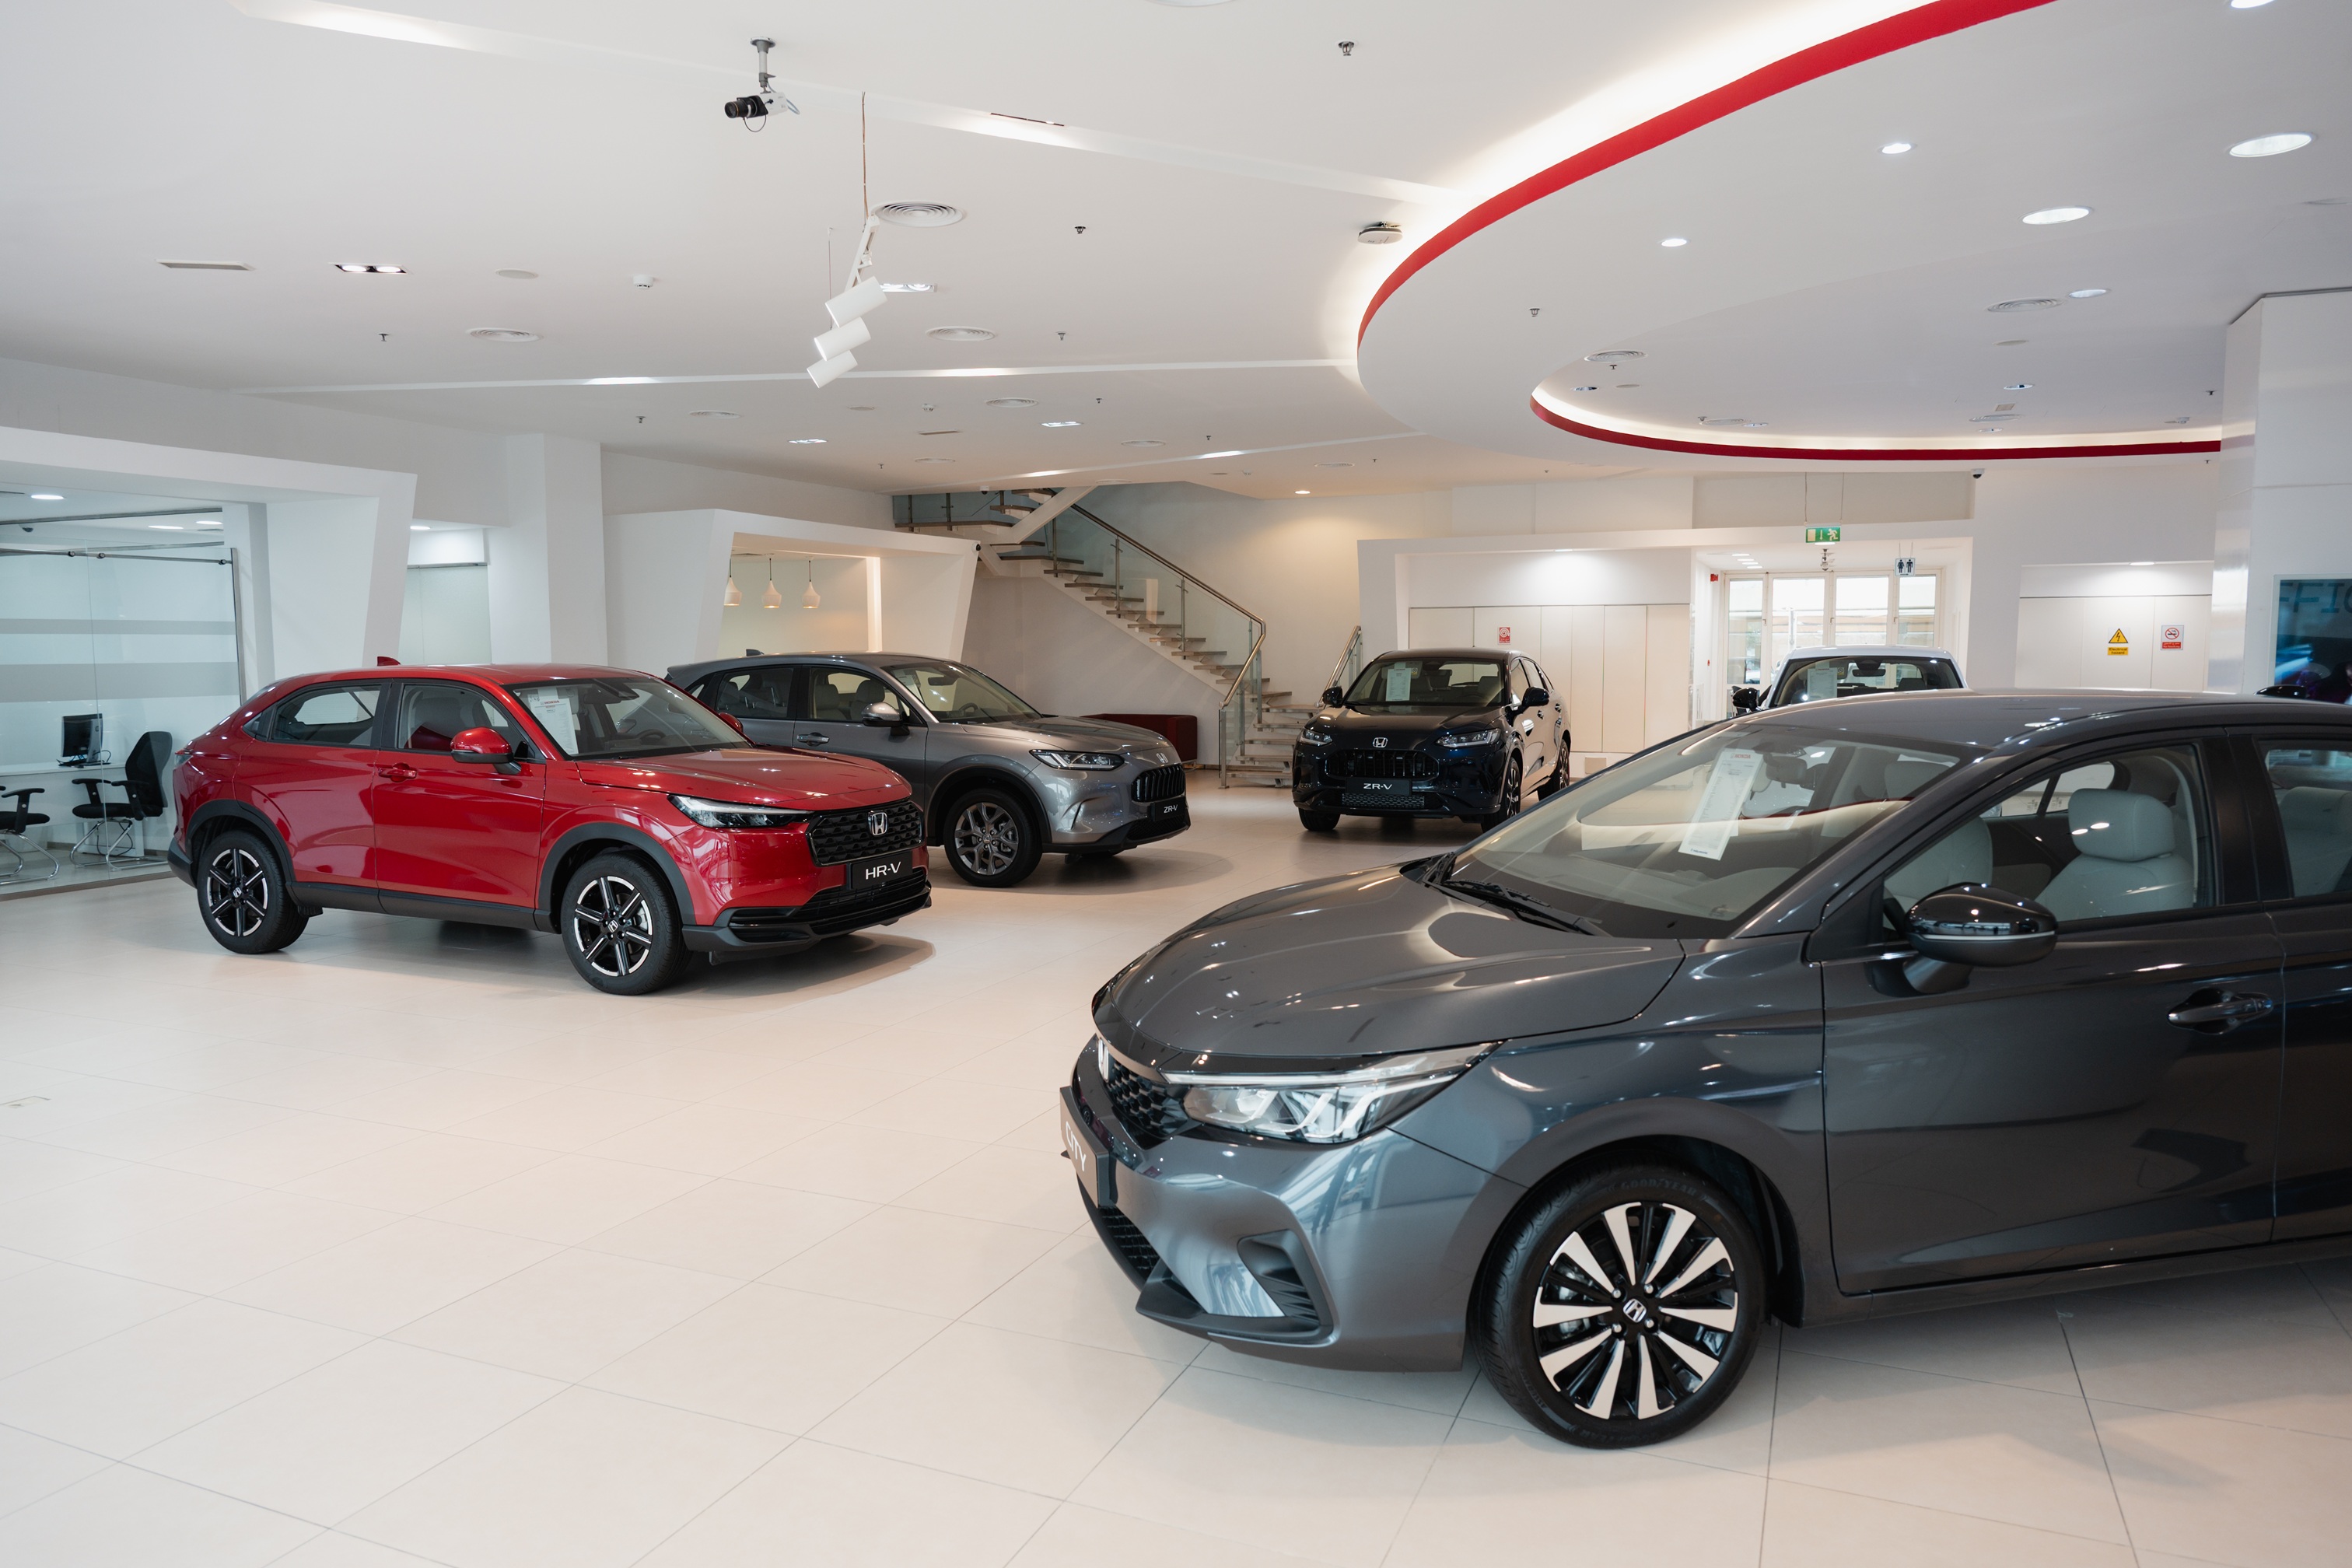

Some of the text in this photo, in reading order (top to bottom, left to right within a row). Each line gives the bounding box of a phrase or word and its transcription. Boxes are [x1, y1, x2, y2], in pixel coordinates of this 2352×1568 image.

[1164, 804, 1178, 814] ZR-V
[865, 861, 901, 880] HR-V
[1066, 1121, 1087, 1172] CITY
